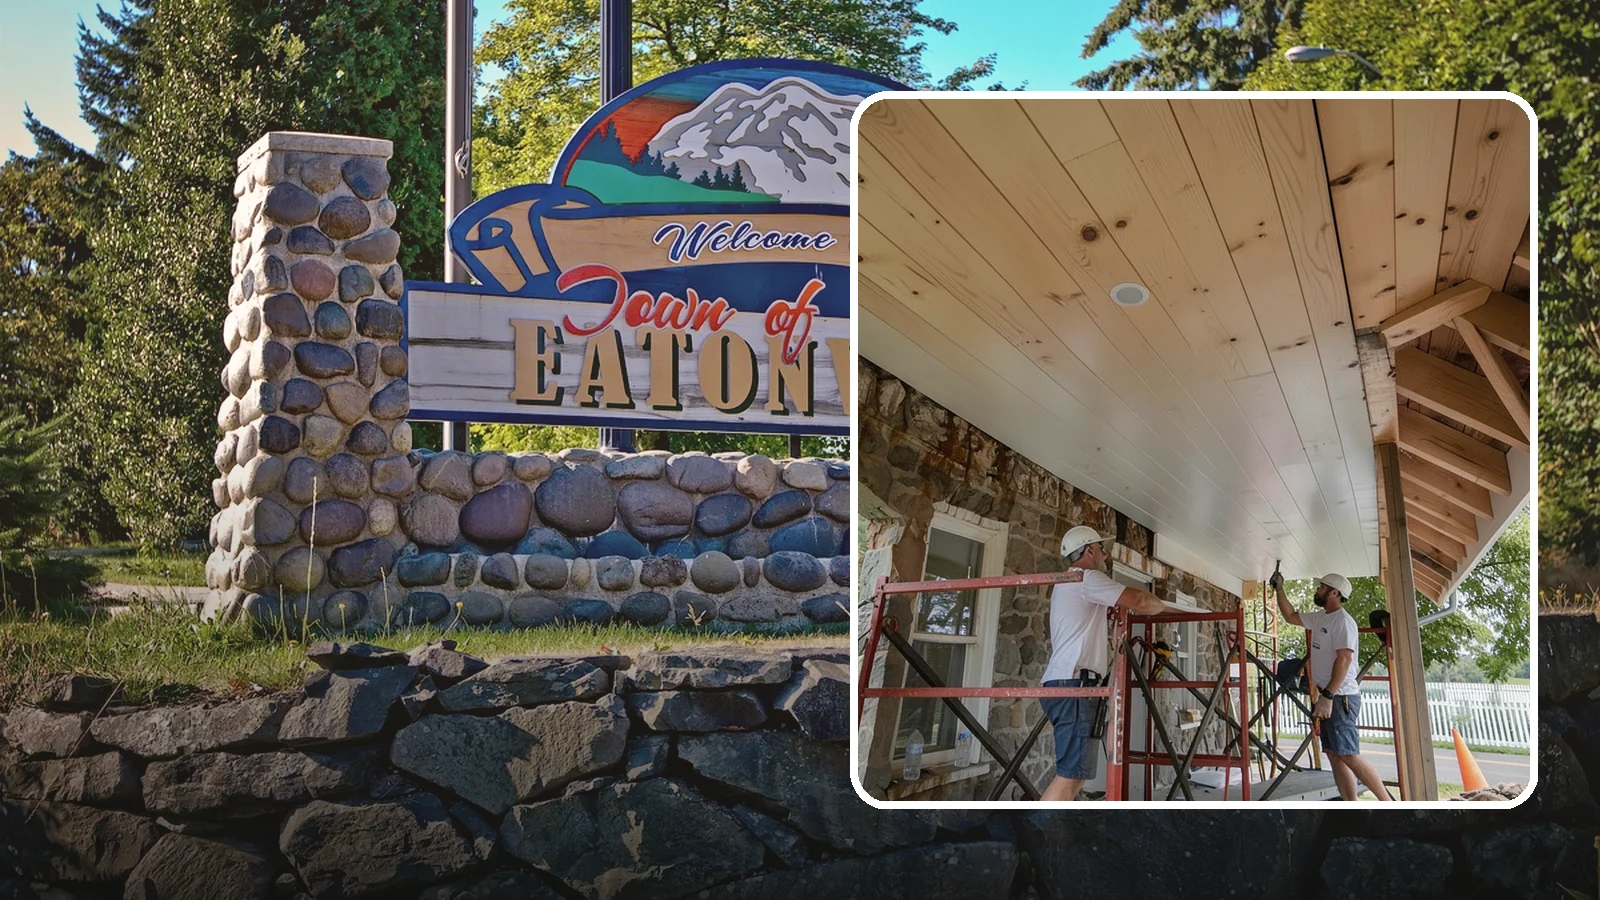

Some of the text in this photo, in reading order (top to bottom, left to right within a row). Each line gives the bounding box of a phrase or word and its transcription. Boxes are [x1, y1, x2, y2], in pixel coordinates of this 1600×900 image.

[653, 220, 837, 262] Welcome
[557, 263, 826, 366] Town of
